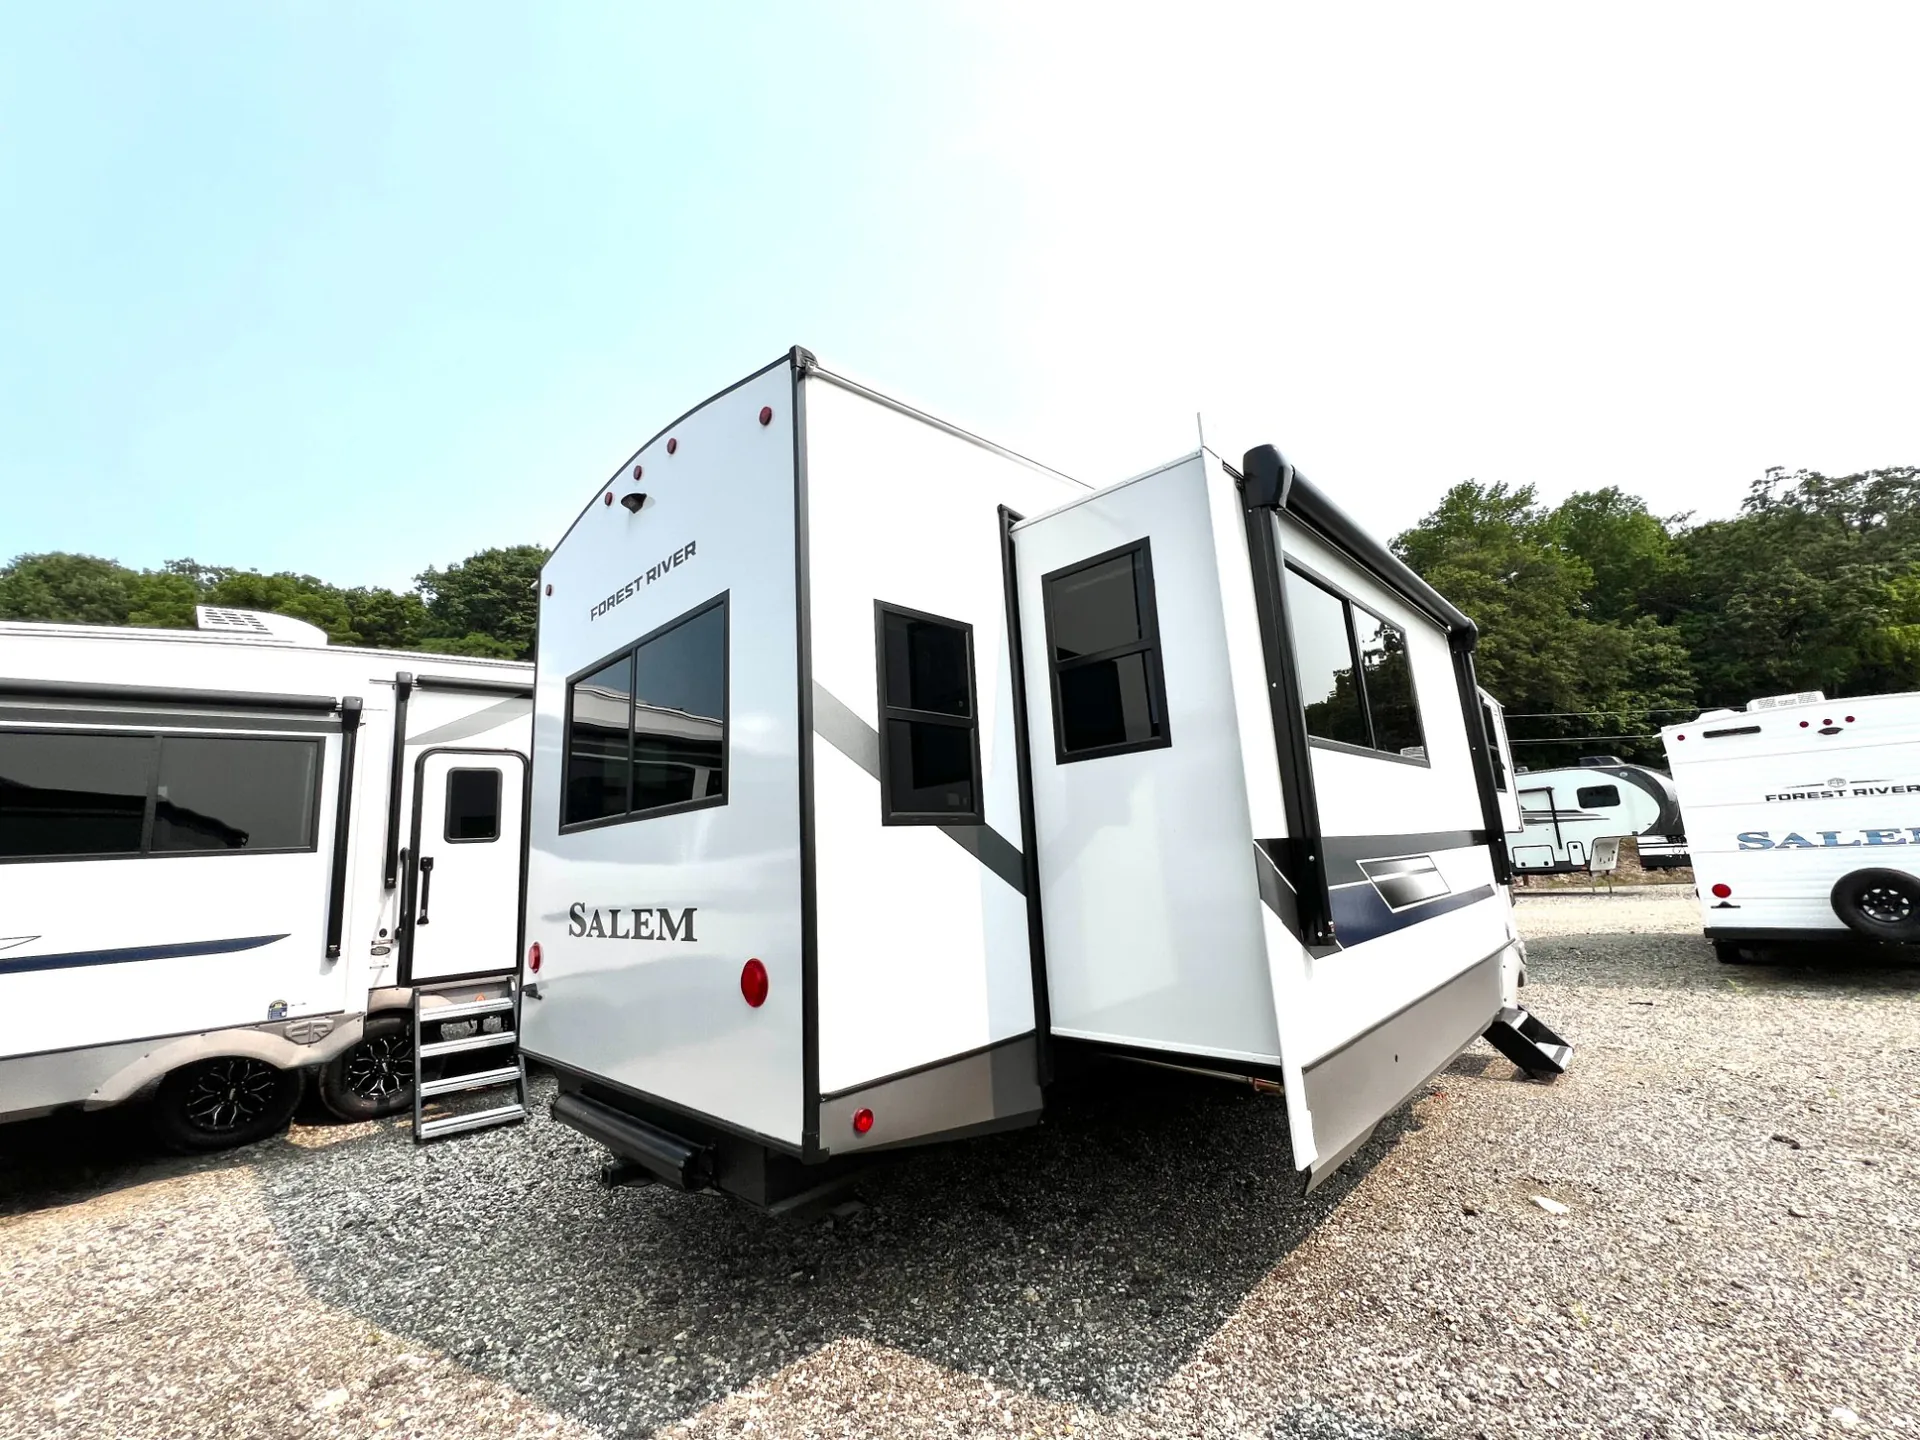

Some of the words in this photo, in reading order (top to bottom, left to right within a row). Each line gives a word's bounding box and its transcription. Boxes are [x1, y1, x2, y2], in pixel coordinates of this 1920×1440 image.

[590, 575, 644, 622] FOREST
[645, 540, 697, 585] RIVER
[1765, 789, 1848, 802] FOREST
[1853, 785, 1920, 796] RIVER
[569, 902, 698, 942] SALEM
